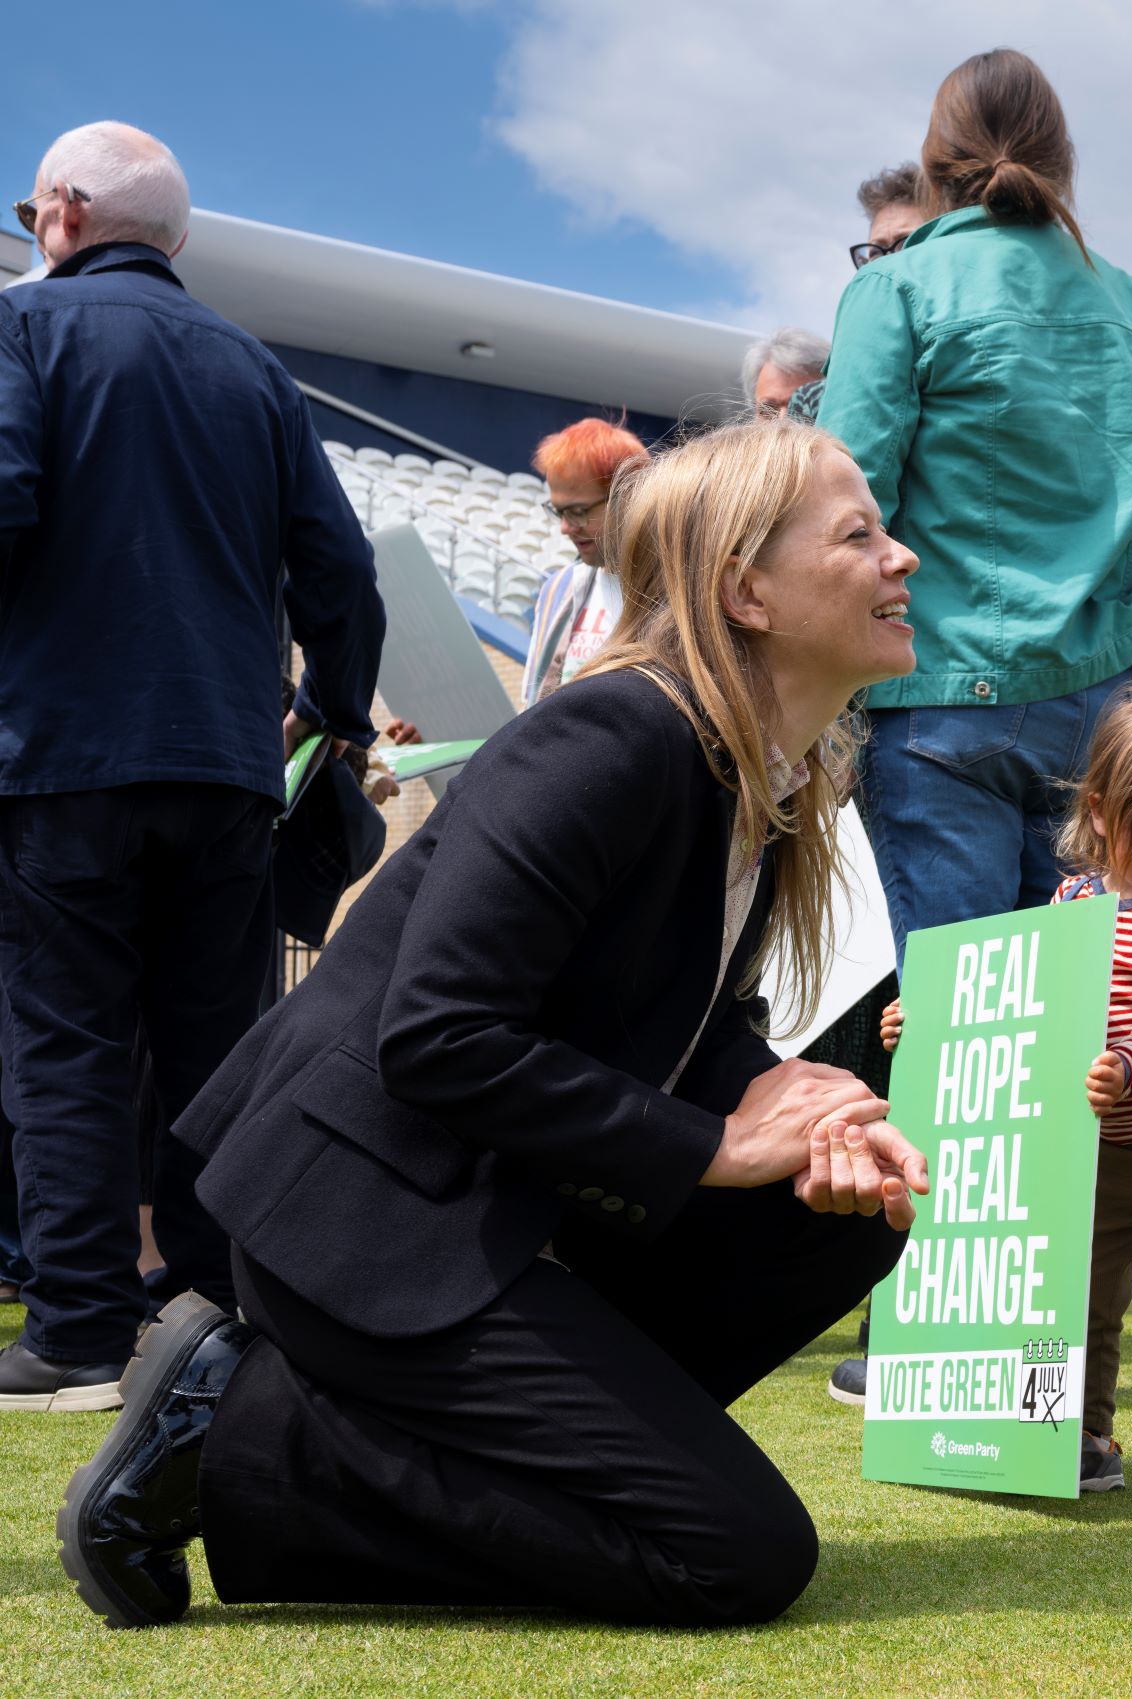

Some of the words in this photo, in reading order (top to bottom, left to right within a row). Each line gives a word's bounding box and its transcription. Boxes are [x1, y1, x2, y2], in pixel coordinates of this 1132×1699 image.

[572, 607, 606, 633] LL
[950, 931, 1045, 1027] REAL
[934, 1031, 1042, 1126] HOPE.
[933, 1134, 1028, 1224] REAL
[895, 1235, 1057, 1326] CHANGE.
[880, 1359, 935, 1413] VOTE
[939, 1357, 1016, 1413] GREEN
[1022, 1367, 1037, 1419] 4
[1037, 1366, 1065, 1394] JULY
[948, 1440, 974, 1456] Green
[976, 1442, 1001, 1461] Party
